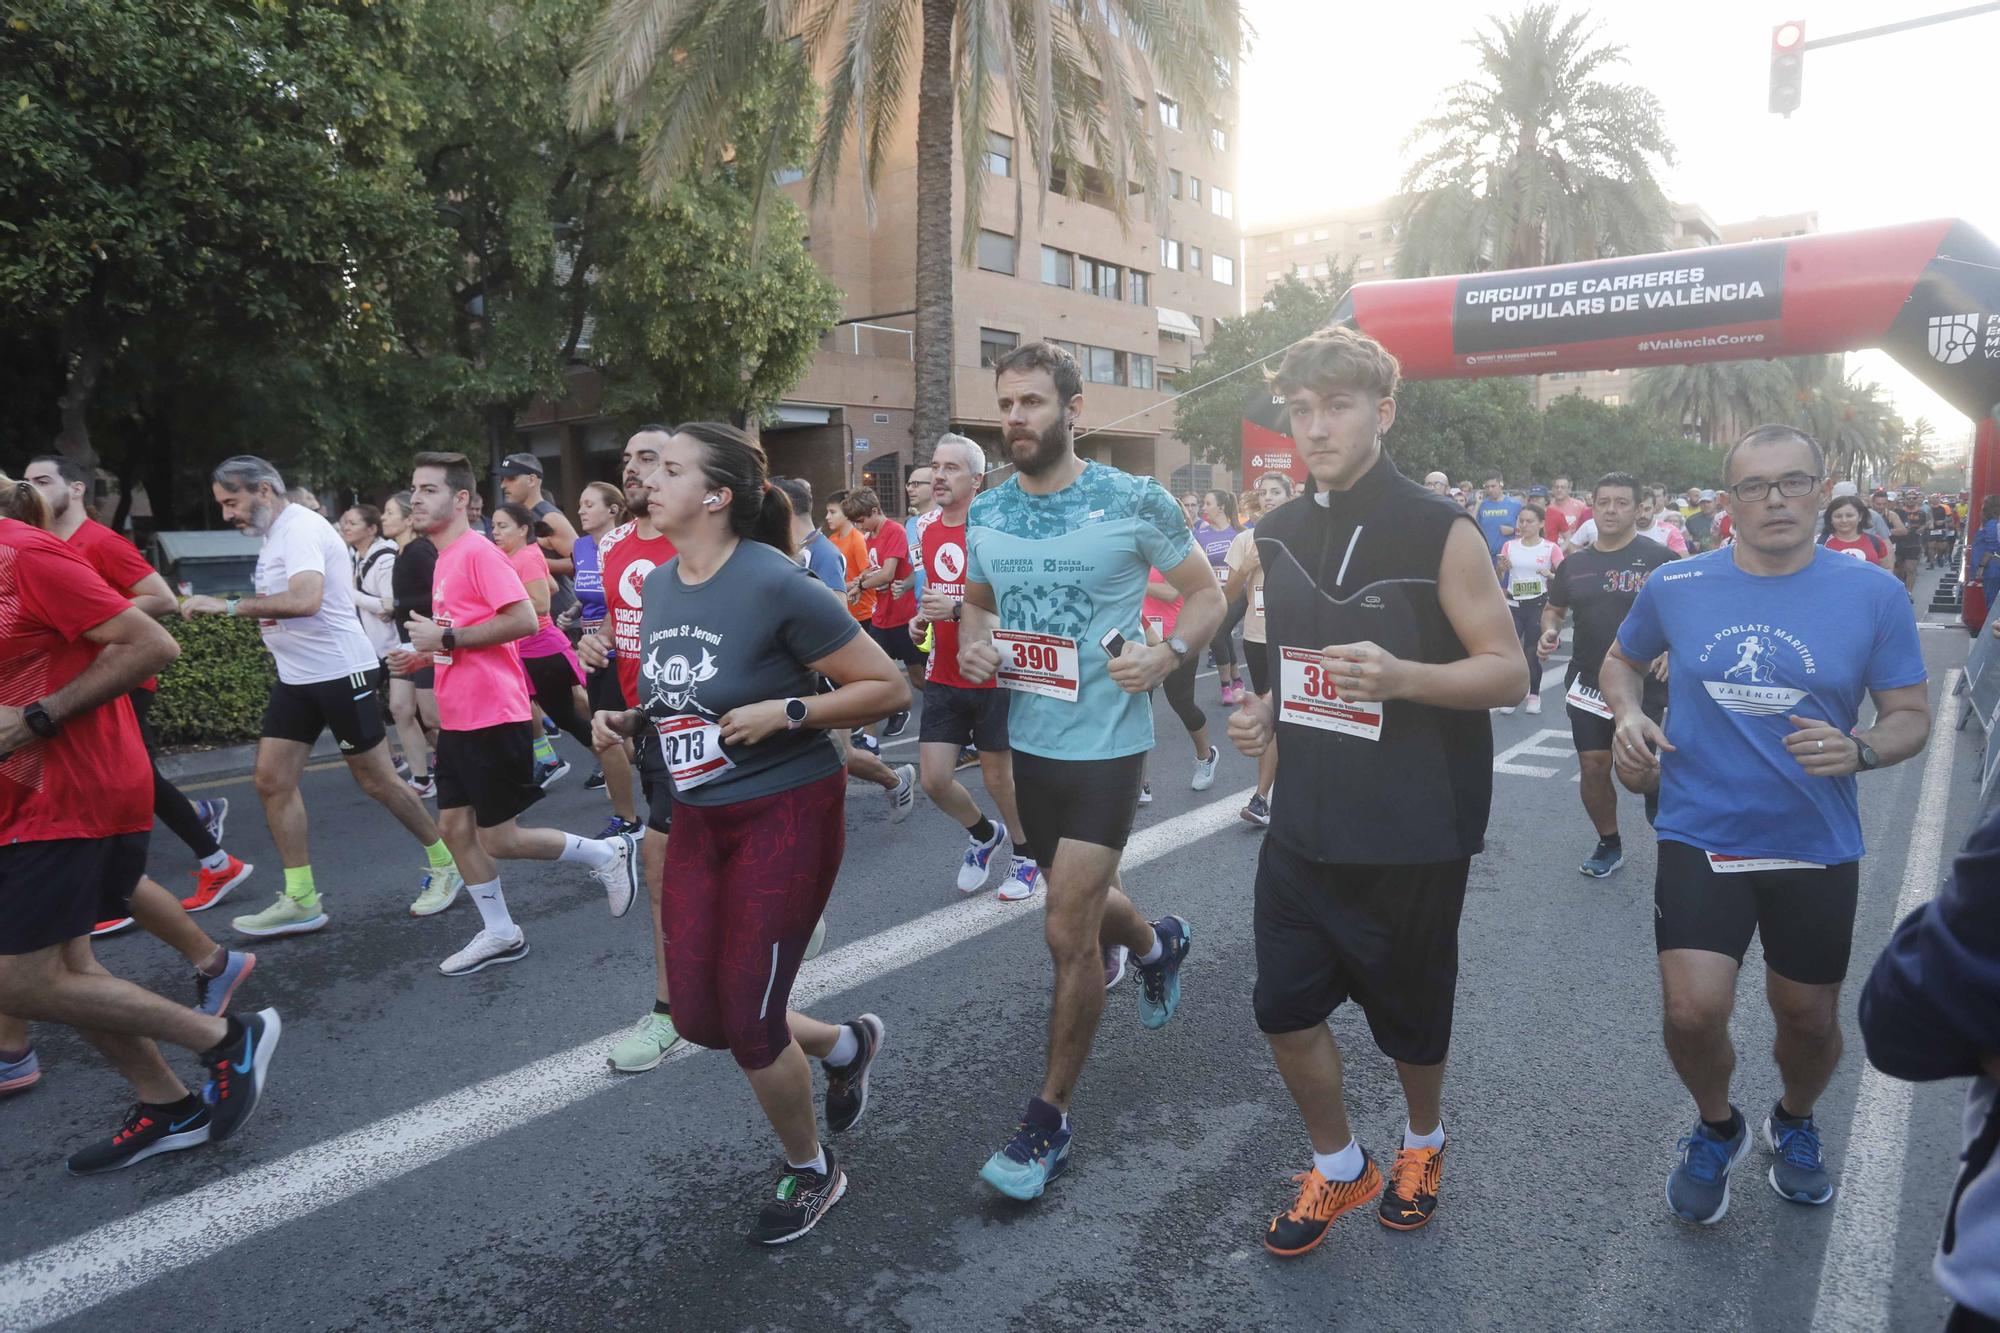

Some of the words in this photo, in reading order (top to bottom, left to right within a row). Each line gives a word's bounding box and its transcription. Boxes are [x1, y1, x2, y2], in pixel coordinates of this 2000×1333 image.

[1465, 284, 1546, 305] CIRCUIT
[1549, 281, 1578, 298] DE
[1582, 267, 1705, 294] CARRERES
[1491, 298, 1605, 323] POPULARS
[1610, 296, 1640, 312] DE
[1644, 280, 1765, 310] VALÈNCIA
[1987, 314, 2000, 324] F
[1637, 333, 1764, 352] #ValènciaCorre
[680, 625, 690, 637] St
[691, 626, 723, 646] Jeroni
[1700, 642, 1717, 662] C.A.
[1714, 624, 1770, 641] POBLATS
[1012, 643, 1058, 672] 390
[1304, 665, 1355, 704] 38
